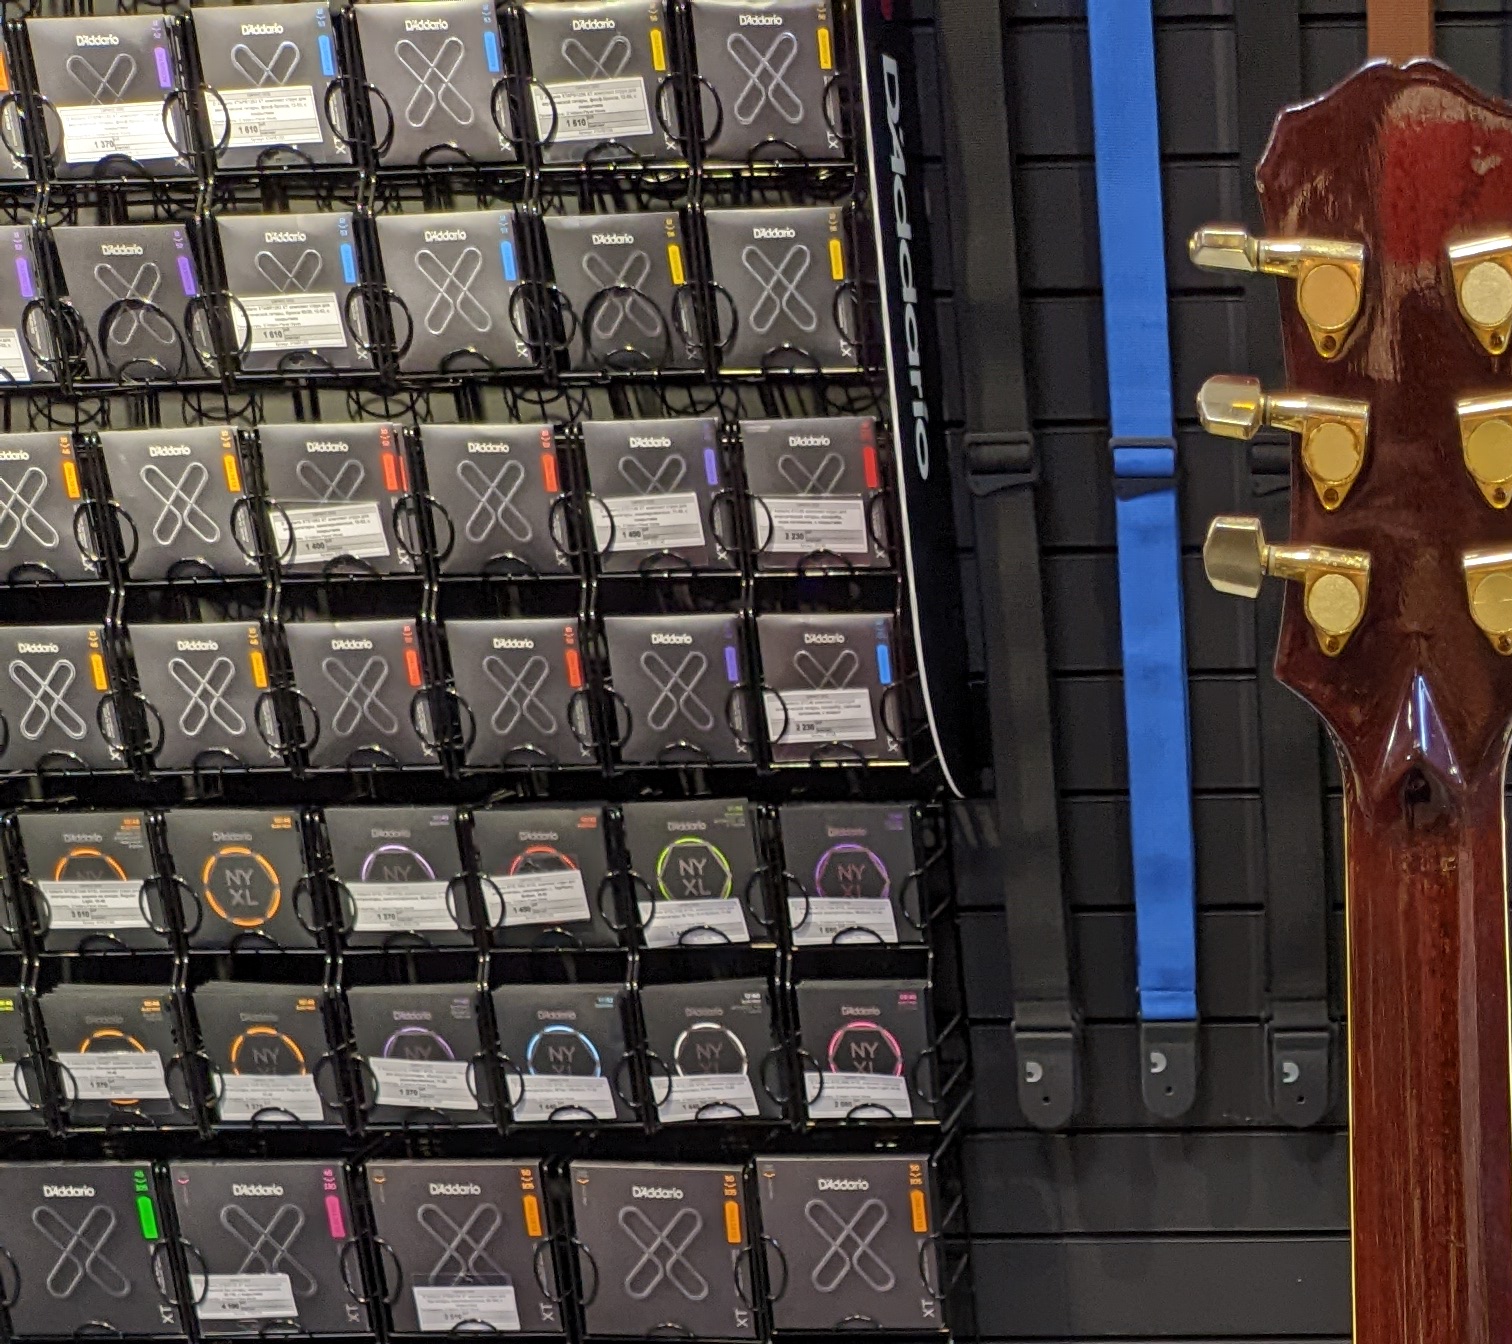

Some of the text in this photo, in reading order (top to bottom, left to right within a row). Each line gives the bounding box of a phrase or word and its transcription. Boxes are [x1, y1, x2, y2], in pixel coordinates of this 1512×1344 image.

[405, 20, 448, 31] D'Addario
[572, 19, 615, 30] D'Addario
[739, 15, 782, 26] D'Addario
[241, 24, 284, 35] D'Addario
[76, 35, 119, 46] D'Addario
[265, 232, 307, 243] D'Addario
[424, 230, 467, 242] D'Addario
[753, 228, 795, 239] D'Addario
[592, 234, 634, 245] D'Addario
[101, 245, 143, 256] D'Addario
[307, 441, 348, 453] D'Addario
[629, 437, 671, 448] D'Addario
[789, 436, 830, 448] D'Addario
[149, 445, 191, 457] D'Addario
[468, 442, 509, 454] D'Addario
[493, 638, 534, 649] D'Addario
[651, 633, 692, 645] D'Addario
[804, 633, 845, 644] D'Addario
[18, 643, 59, 654] D'Addario
[177, 640, 218, 651] D'Addario
[331, 639, 372, 650] D'Addario
[679, 858, 707, 877] NY
[682, 878, 711, 896] XL
[232, 1183, 283, 1197] D'Addario
[429, 1182, 481, 1196] D'Addario
[818, 1178, 869, 1192] D'Addario
[43, 1185, 95, 1198] D'Addario
[632, 1186, 683, 1201] D'Addario
